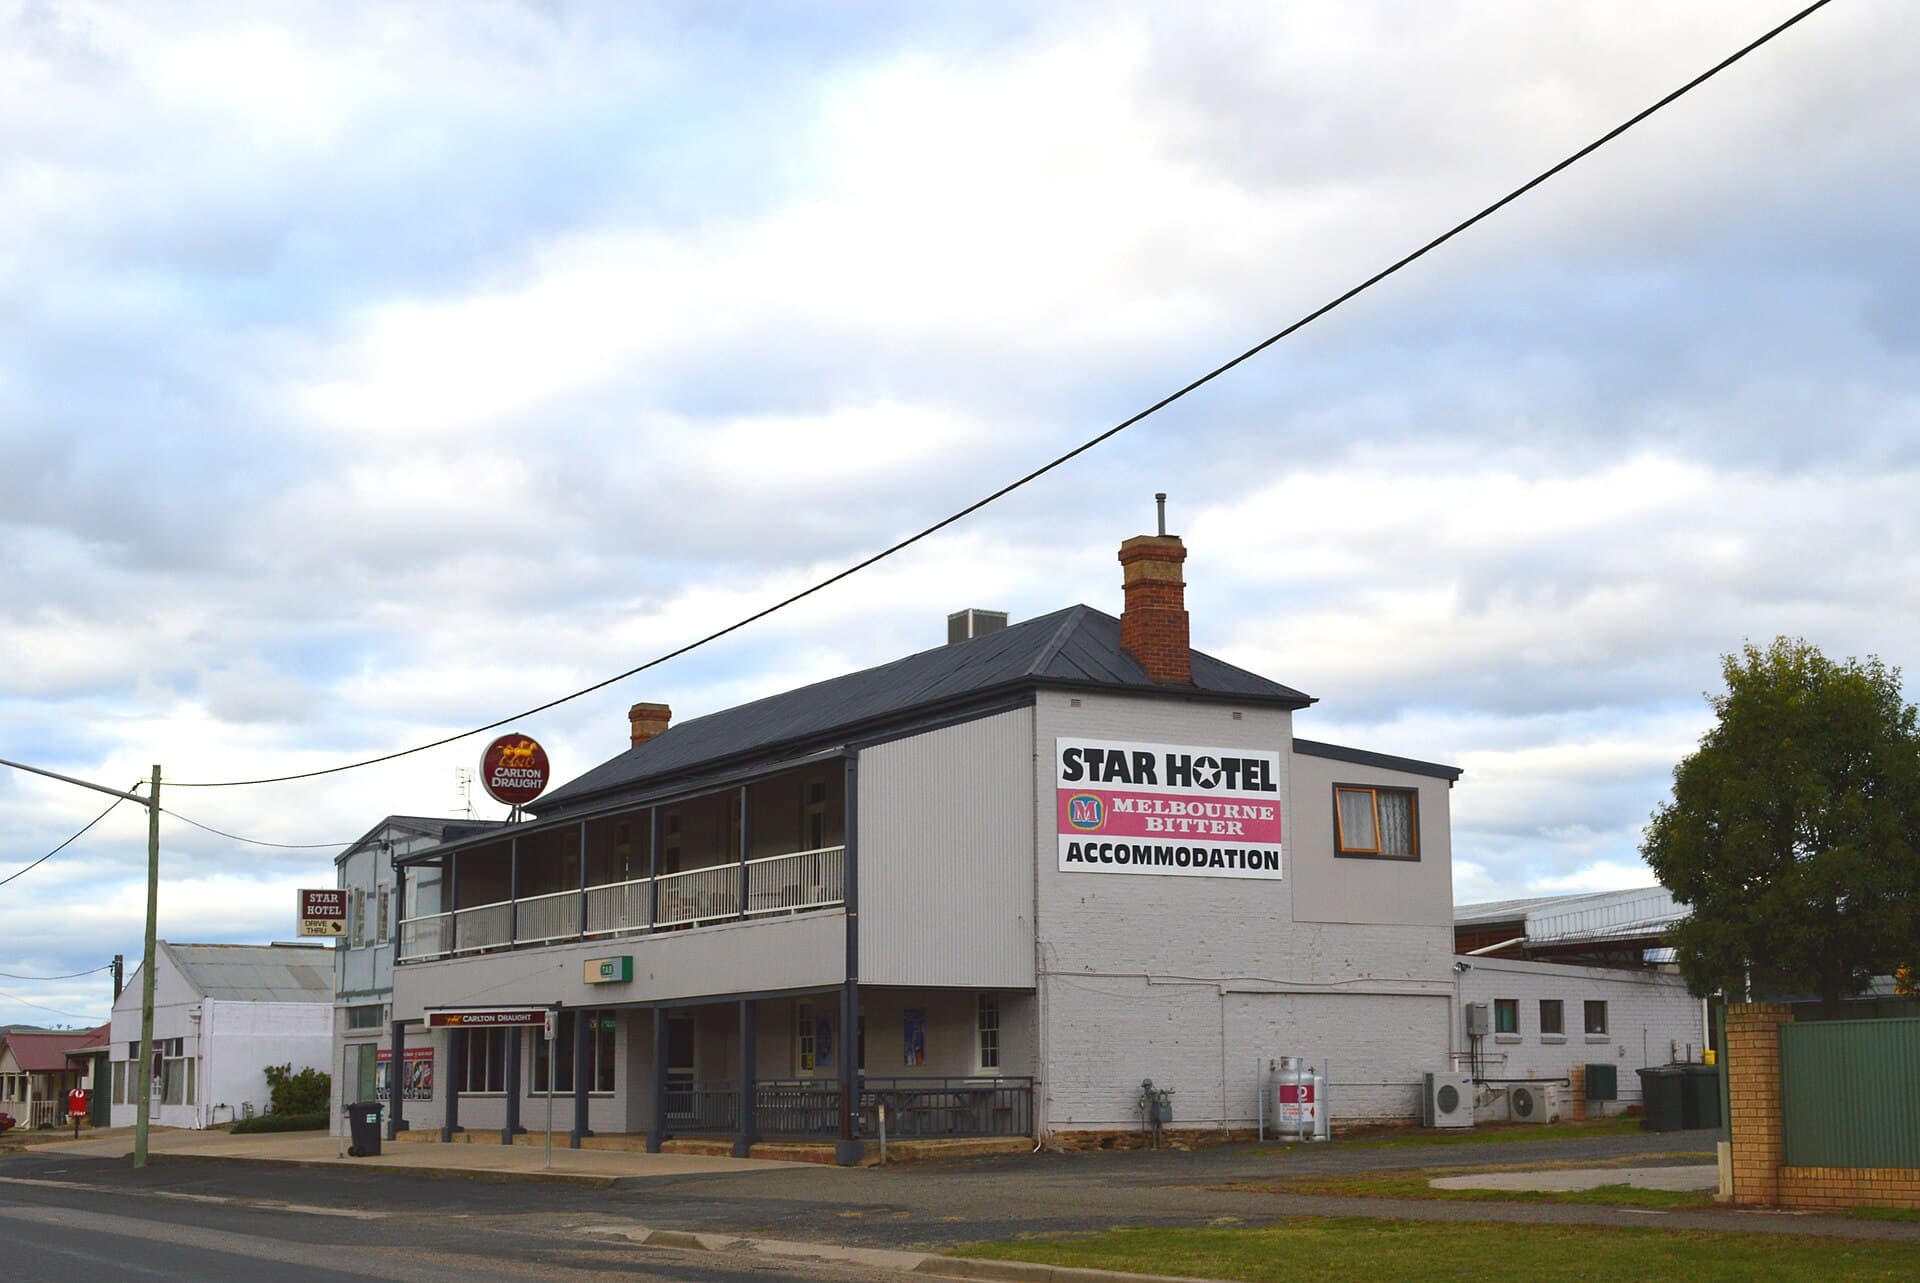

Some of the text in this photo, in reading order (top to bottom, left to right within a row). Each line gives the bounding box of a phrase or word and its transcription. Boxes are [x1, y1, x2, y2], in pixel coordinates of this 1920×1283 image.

[494, 767, 542, 778] CARLTON
[1062, 747, 1277, 792] STAR HOTEL
[491, 777, 543, 788] DRAUGHT
[1072, 799, 1099, 823] M
[1112, 797, 1274, 821] MELBOURNE
[1145, 816, 1245, 836] BITTER
[1066, 842, 1279, 870] ACCOMMODATION
[309, 893, 339, 903] STAR
[307, 905, 342, 915] HOTEL
[462, 1014, 532, 1023] CARLTON DRAUGHT
